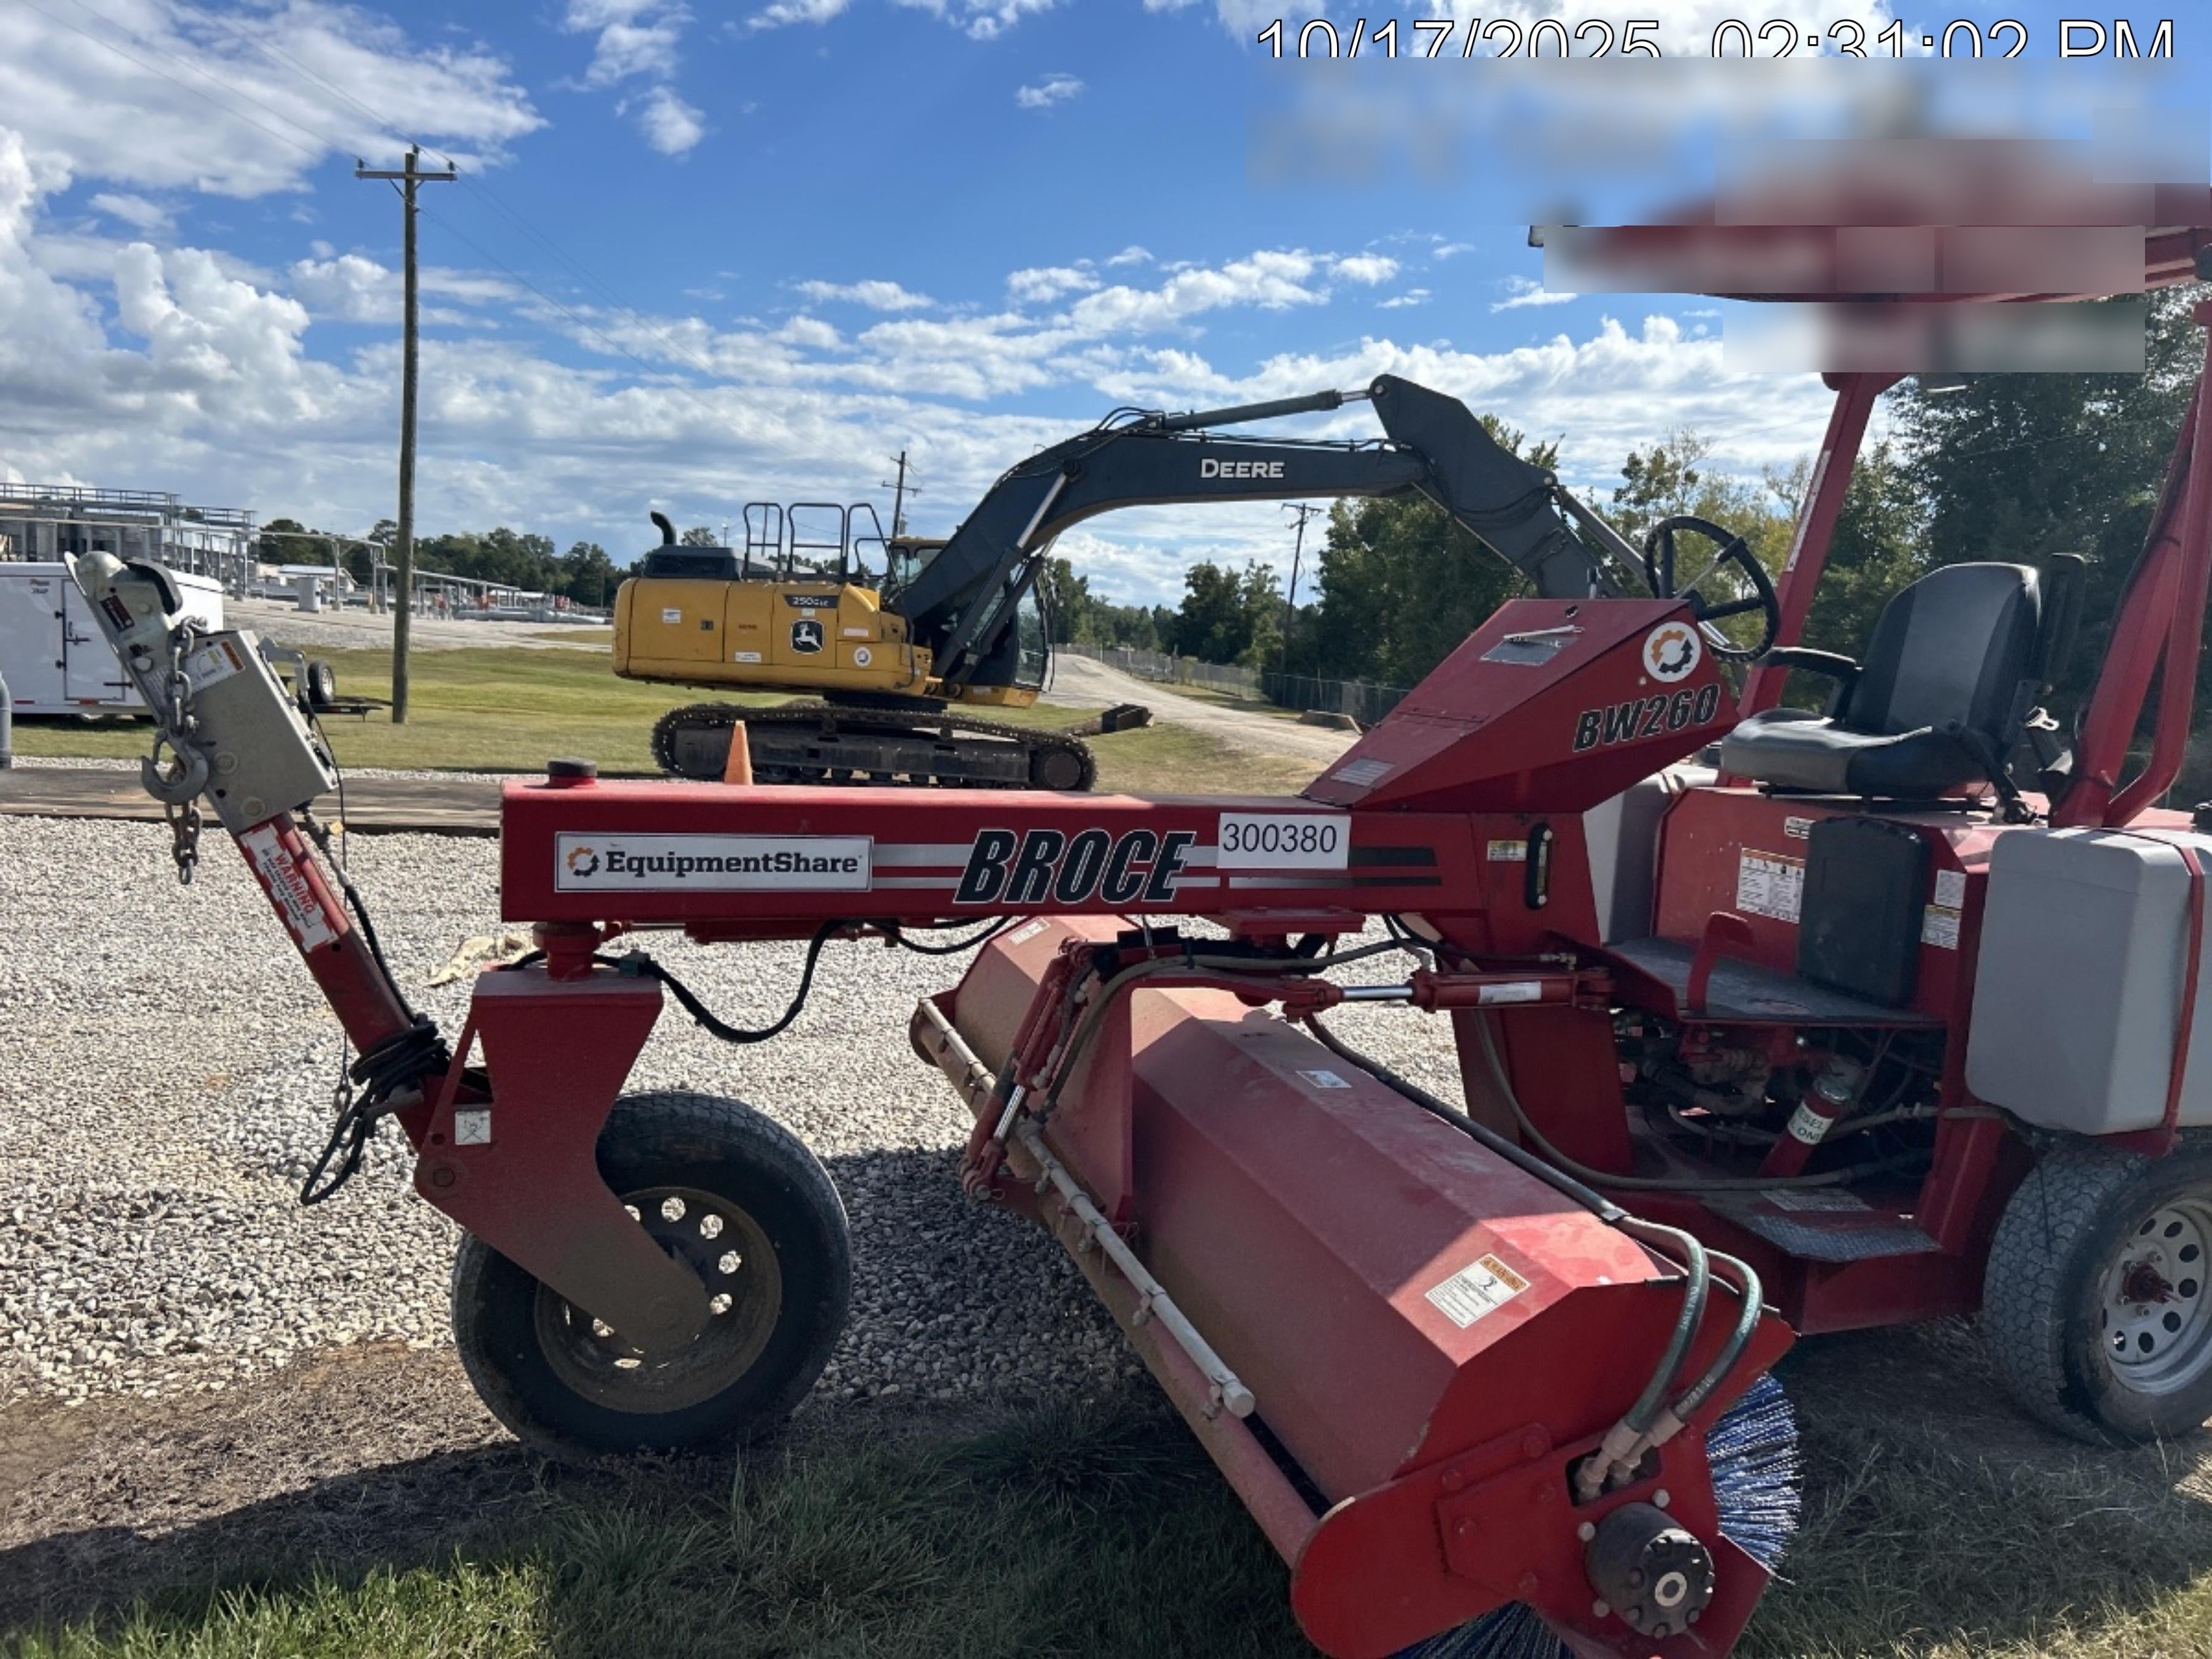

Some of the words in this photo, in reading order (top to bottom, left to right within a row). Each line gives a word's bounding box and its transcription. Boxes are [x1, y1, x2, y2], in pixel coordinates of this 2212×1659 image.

[1201, 458, 1285, 479] DEERE
[1572, 684, 1720, 752] BW260
[1223, 823, 1336, 853] 300380
[606, 850, 858, 877] EquipmentShare
[953, 829, 1196, 904] BROCE
